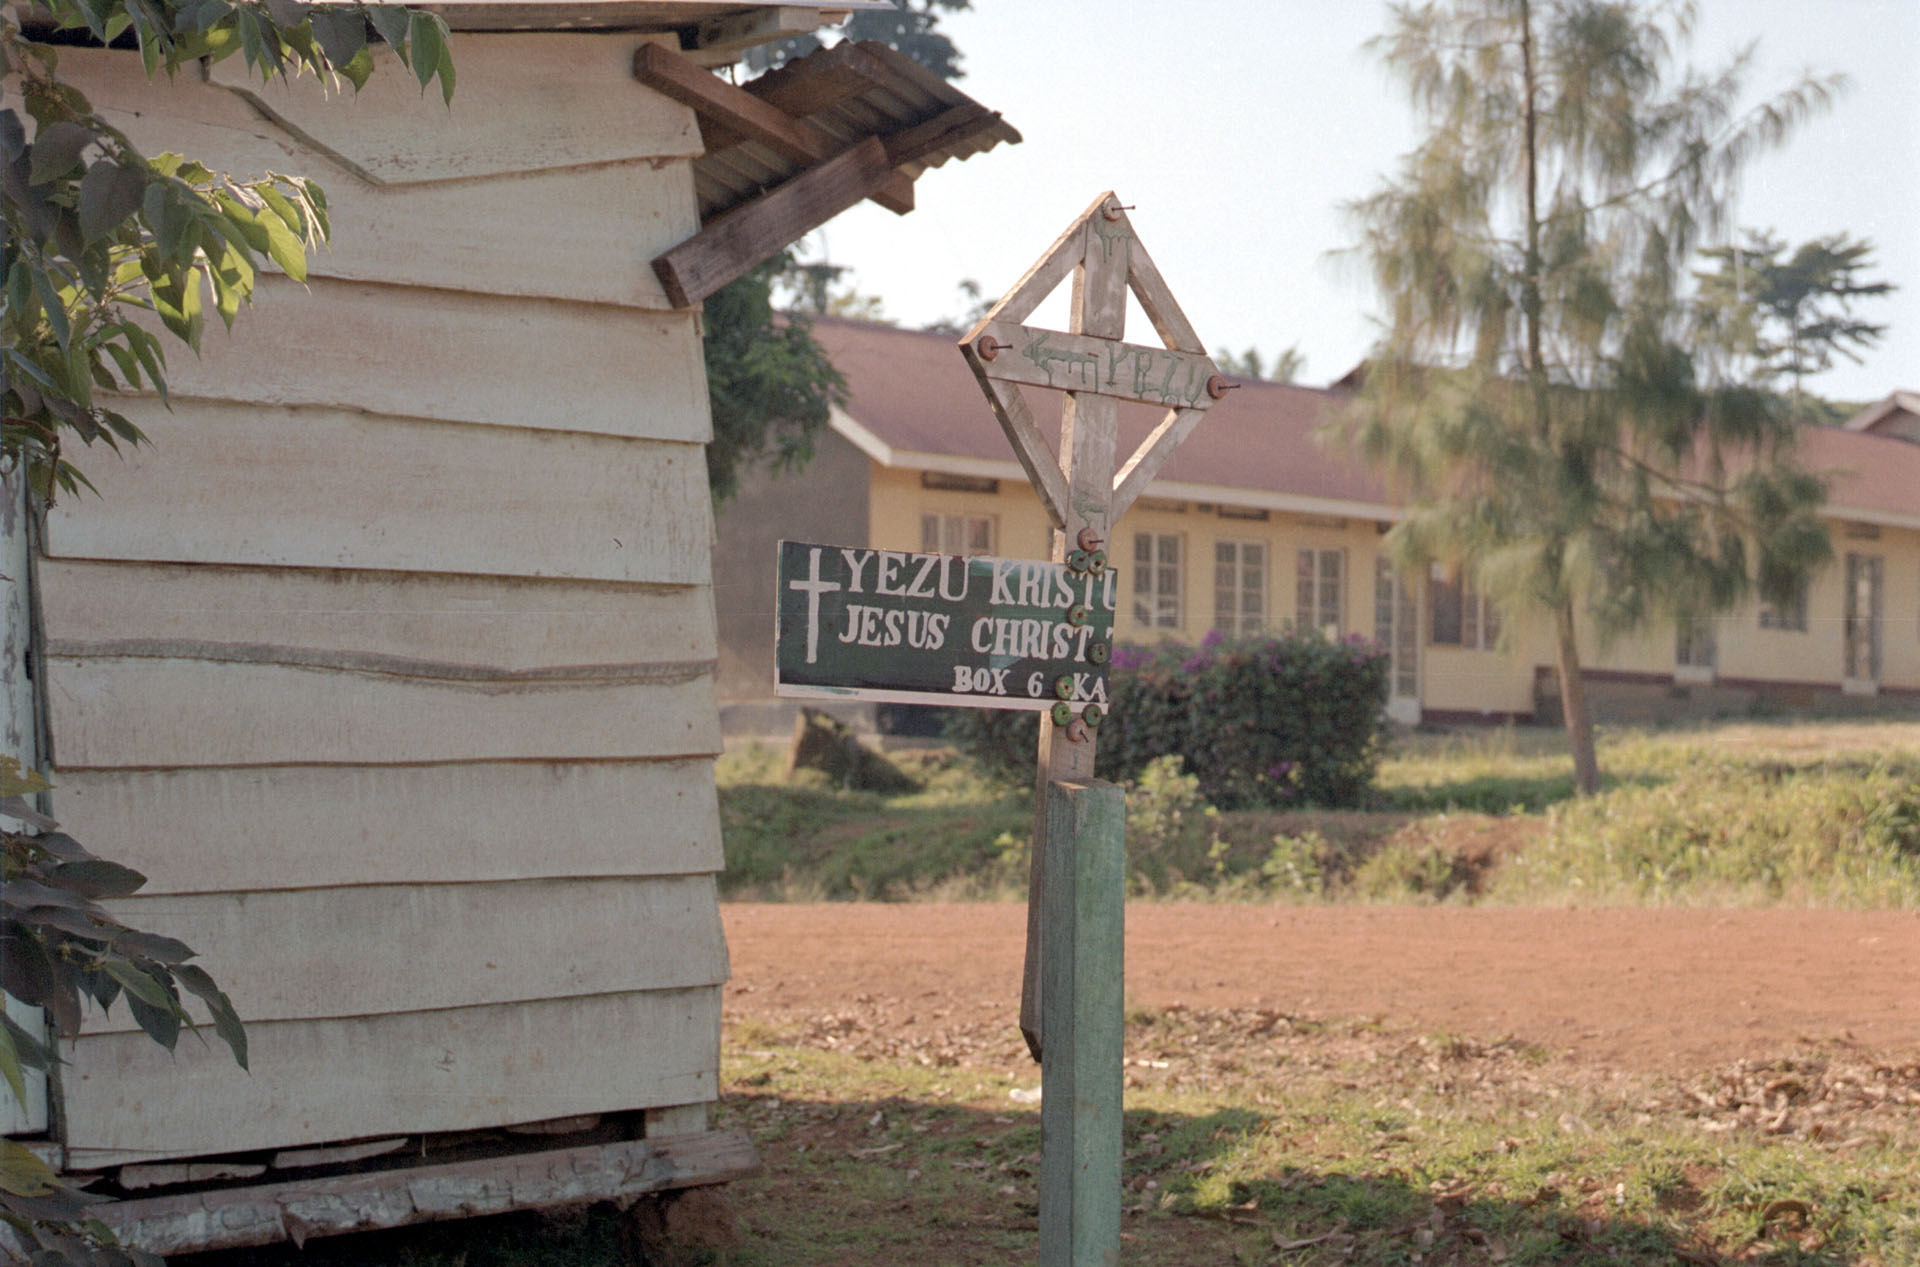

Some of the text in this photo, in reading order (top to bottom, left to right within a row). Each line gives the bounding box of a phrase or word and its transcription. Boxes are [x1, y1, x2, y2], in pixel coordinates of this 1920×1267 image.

[841, 549, 1115, 611] YEZU KRISTU
[838, 604, 950, 650] JESUS
[971, 616, 1094, 662] CHRIST
[952, 665, 1011, 696] BOX
[1027, 671, 1044, 698] 6
